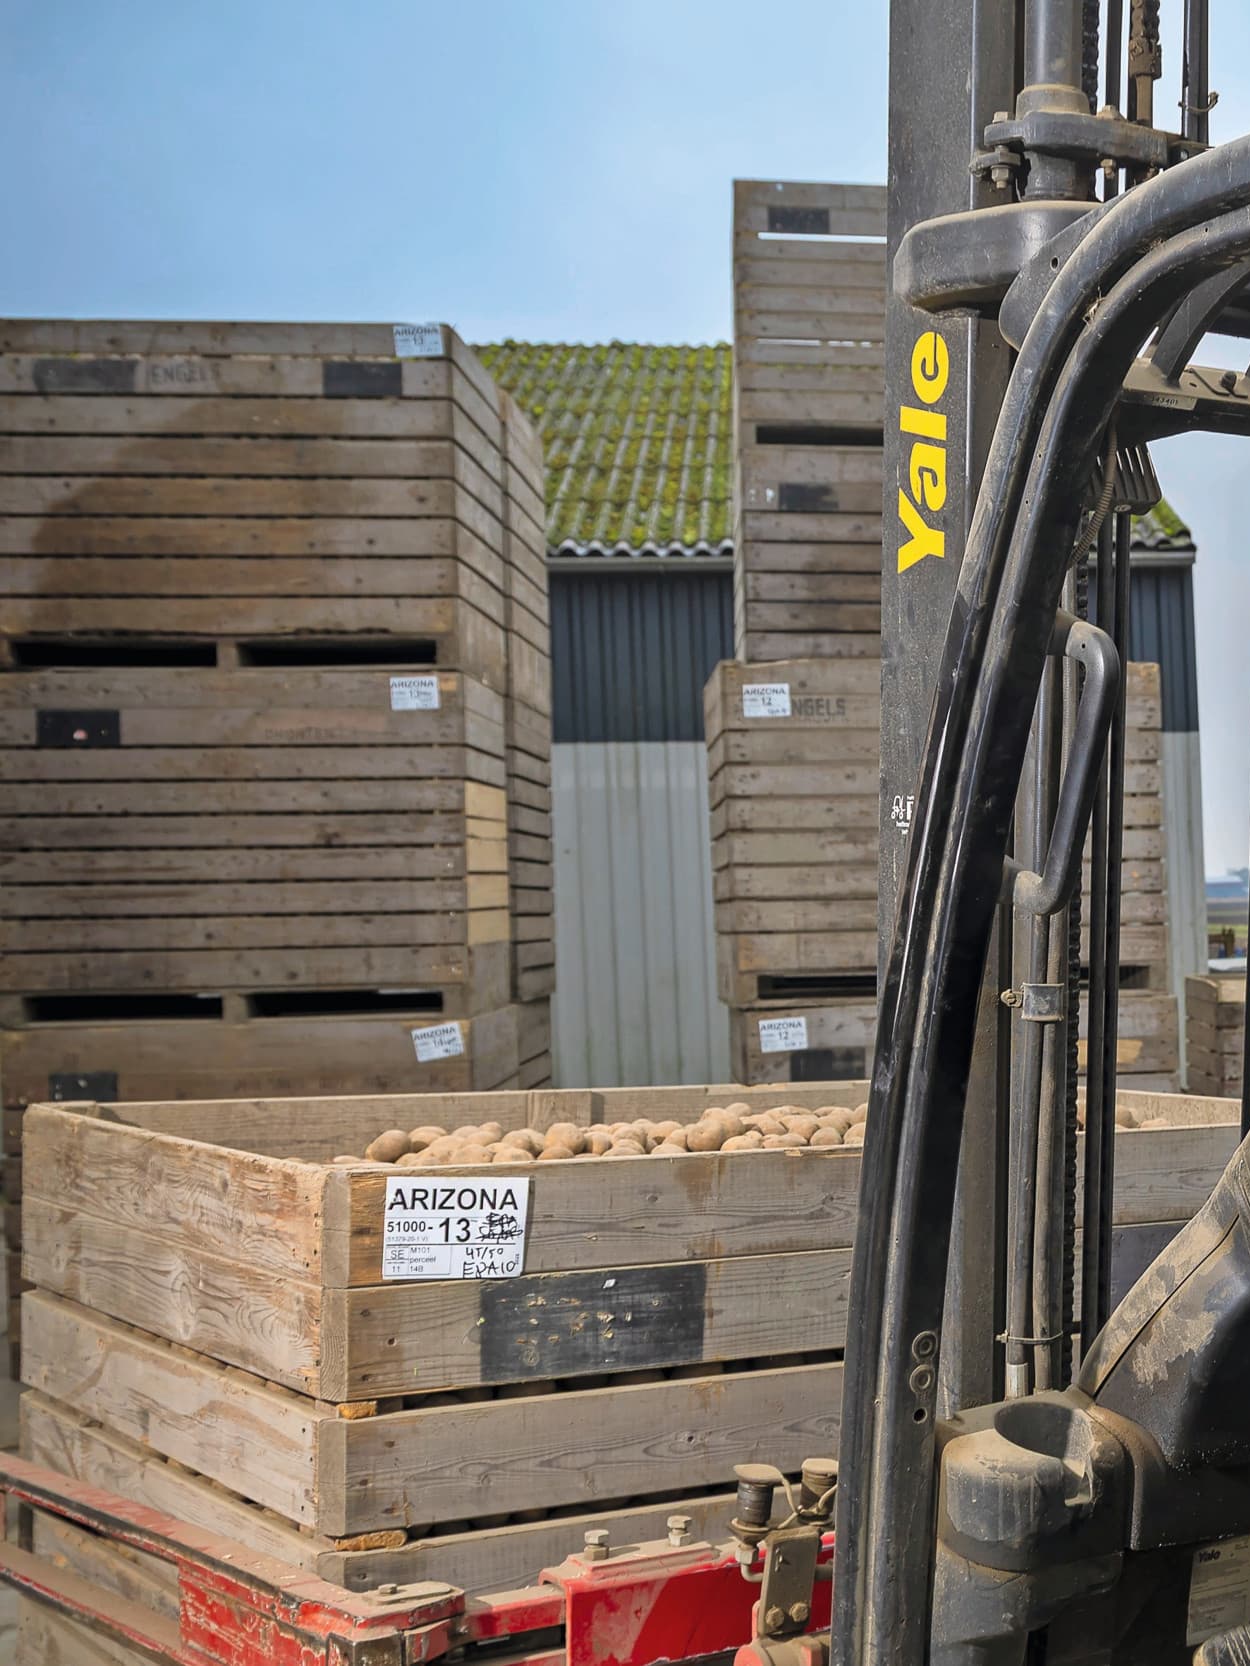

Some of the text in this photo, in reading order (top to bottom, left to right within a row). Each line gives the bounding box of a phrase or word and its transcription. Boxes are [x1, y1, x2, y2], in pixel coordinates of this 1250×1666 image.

[897, 331, 949, 574] Yale
[391, 680, 434, 688] ARIZONA
[743, 687, 786, 696] ARIZONA
[791, 698, 846, 717] NGELS
[761, 1021, 802, 1031] ARIZONA
[414, 1026, 456, 1041] ARIZONA
[388, 1188, 518, 1210] ARIZONA
[387, 1220, 433, 1233] 51000-
[439, 1217, 471, 1242] 13
[390, 1249, 404, 1260] SE
[410, 1256, 436, 1264] perceel
[392, 1265, 400, 1273] 11
